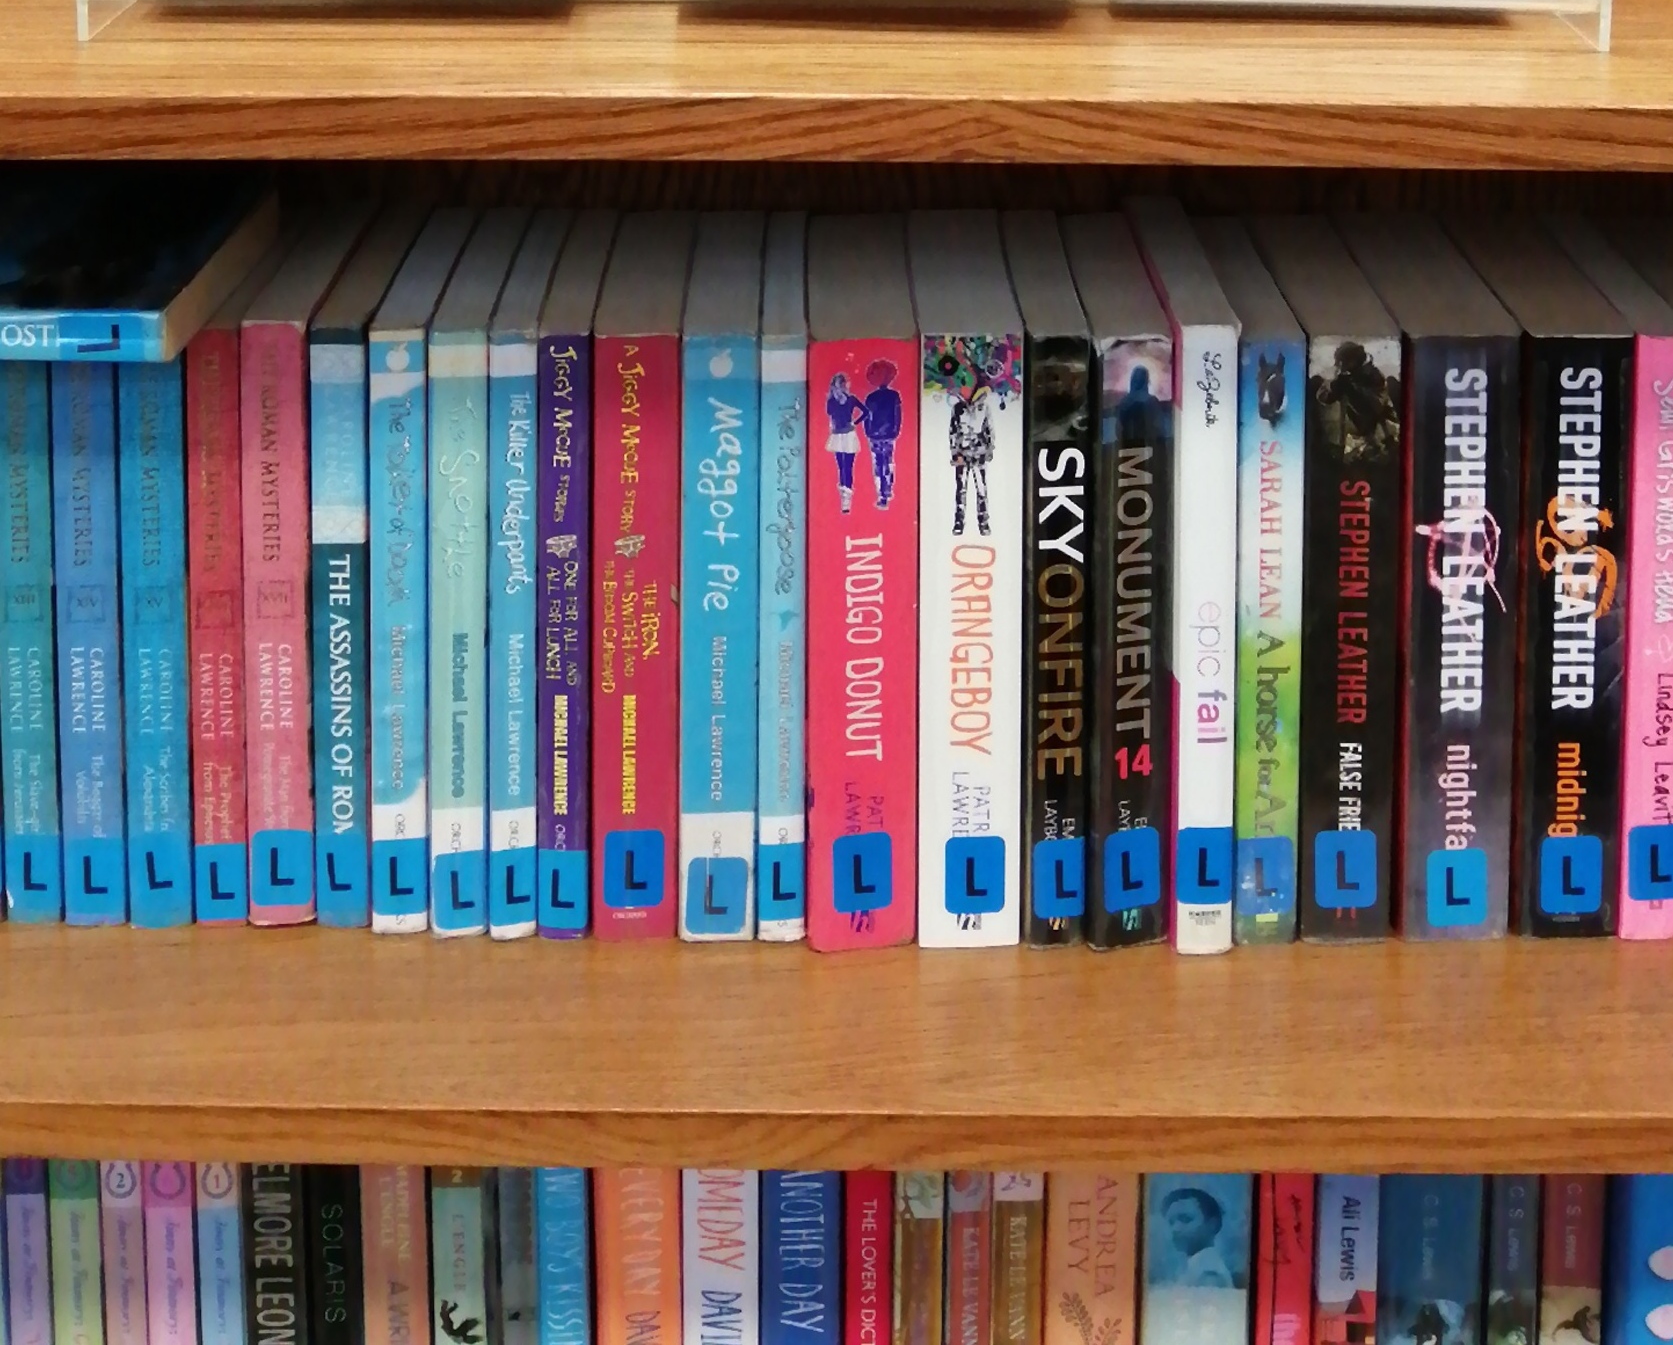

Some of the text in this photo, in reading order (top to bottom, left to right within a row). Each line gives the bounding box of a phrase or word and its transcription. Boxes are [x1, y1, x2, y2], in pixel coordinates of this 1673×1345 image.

[624, 345, 639, 357] A
[260, 460, 283, 562] MYSTERIES
[500, 392, 534, 596] The Killer Underpants
[553, 474, 570, 523] STORIES
[619, 490, 636, 533] STORY
[697, 397, 742, 612] Maggot Pie
[1257, 440, 1281, 543] SARAH
[328, 554, 350, 606] THE
[1439, 367, 1487, 713] STEPHEN LEATHER
[1550, 367, 1602, 710] STEPHEN LEATHER
[546, 565, 562, 679] ALL FOR LUNCH
[563, 561, 579, 685] ONE FOR ALL AND
[641, 581, 658, 608] THE
[1114, 446, 1154, 780] MONUMENT 14
[1258, 549, 1281, 619] LEAN
[1336, 481, 1371, 724] STEPHEN LEATHER
[279, 644, 293, 729] CAROLINE
[328, 613, 352, 738] ASSASSINS
[844, 533, 884, 761] INDIGO DONUT
[949, 544, 996, 755] ORANGEBOY
[1190, 601, 1228, 745] epic fail
[1256, 630, 1283, 658] A
[70, 646, 86, 734] LAWRENCE
[90, 646, 105, 732] CAROLINE
[199, 653, 215, 741] LAWRENCE
[219, 654, 233, 738] CAROLINE
[259, 643, 274, 731] LAWRENCE
[451, 632, 468, 798] Michael Lawrence
[506, 633, 525, 796] Michael Lawrence
[709, 636, 727, 801] Michael Lawrence
[1254, 665, 1290, 753] horse
[1642, 672, 1673, 747] Lindsey
[203, 762, 215, 792] from
[330, 743, 353, 779] OF
[553, 695, 568, 815] MICHAEL LAWRENCE
[622, 695, 636, 815] MICHAEL LAWRENCE
[1338, 743, 1363, 791] FALSE
[217, 766, 232, 840] The Prophet
[23, 851, 48, 891] L
[83, 855, 108, 894] L
[271, 848, 295, 886] L
[625, 850, 648, 889] L
[854, 854, 875, 894] L
[966, 857, 988, 897] L
[1336, 850, 1361, 891] L
[1445, 866, 1470, 906] L
[1561, 856, 1586, 896] L
[252, 1164, 293, 1268] ELMORE
[862, 1199, 877, 1232] THE
[1067, 1201, 1090, 1274] LEVY
[1095, 1175, 1118, 1297] ANDREA
[1339, 1196, 1361, 1281] Ali Lewis
[321, 1205, 346, 1323] SOLARIS
[860, 1236, 876, 1305] LOVER'S
[779, 1284, 824, 1332] DAY
